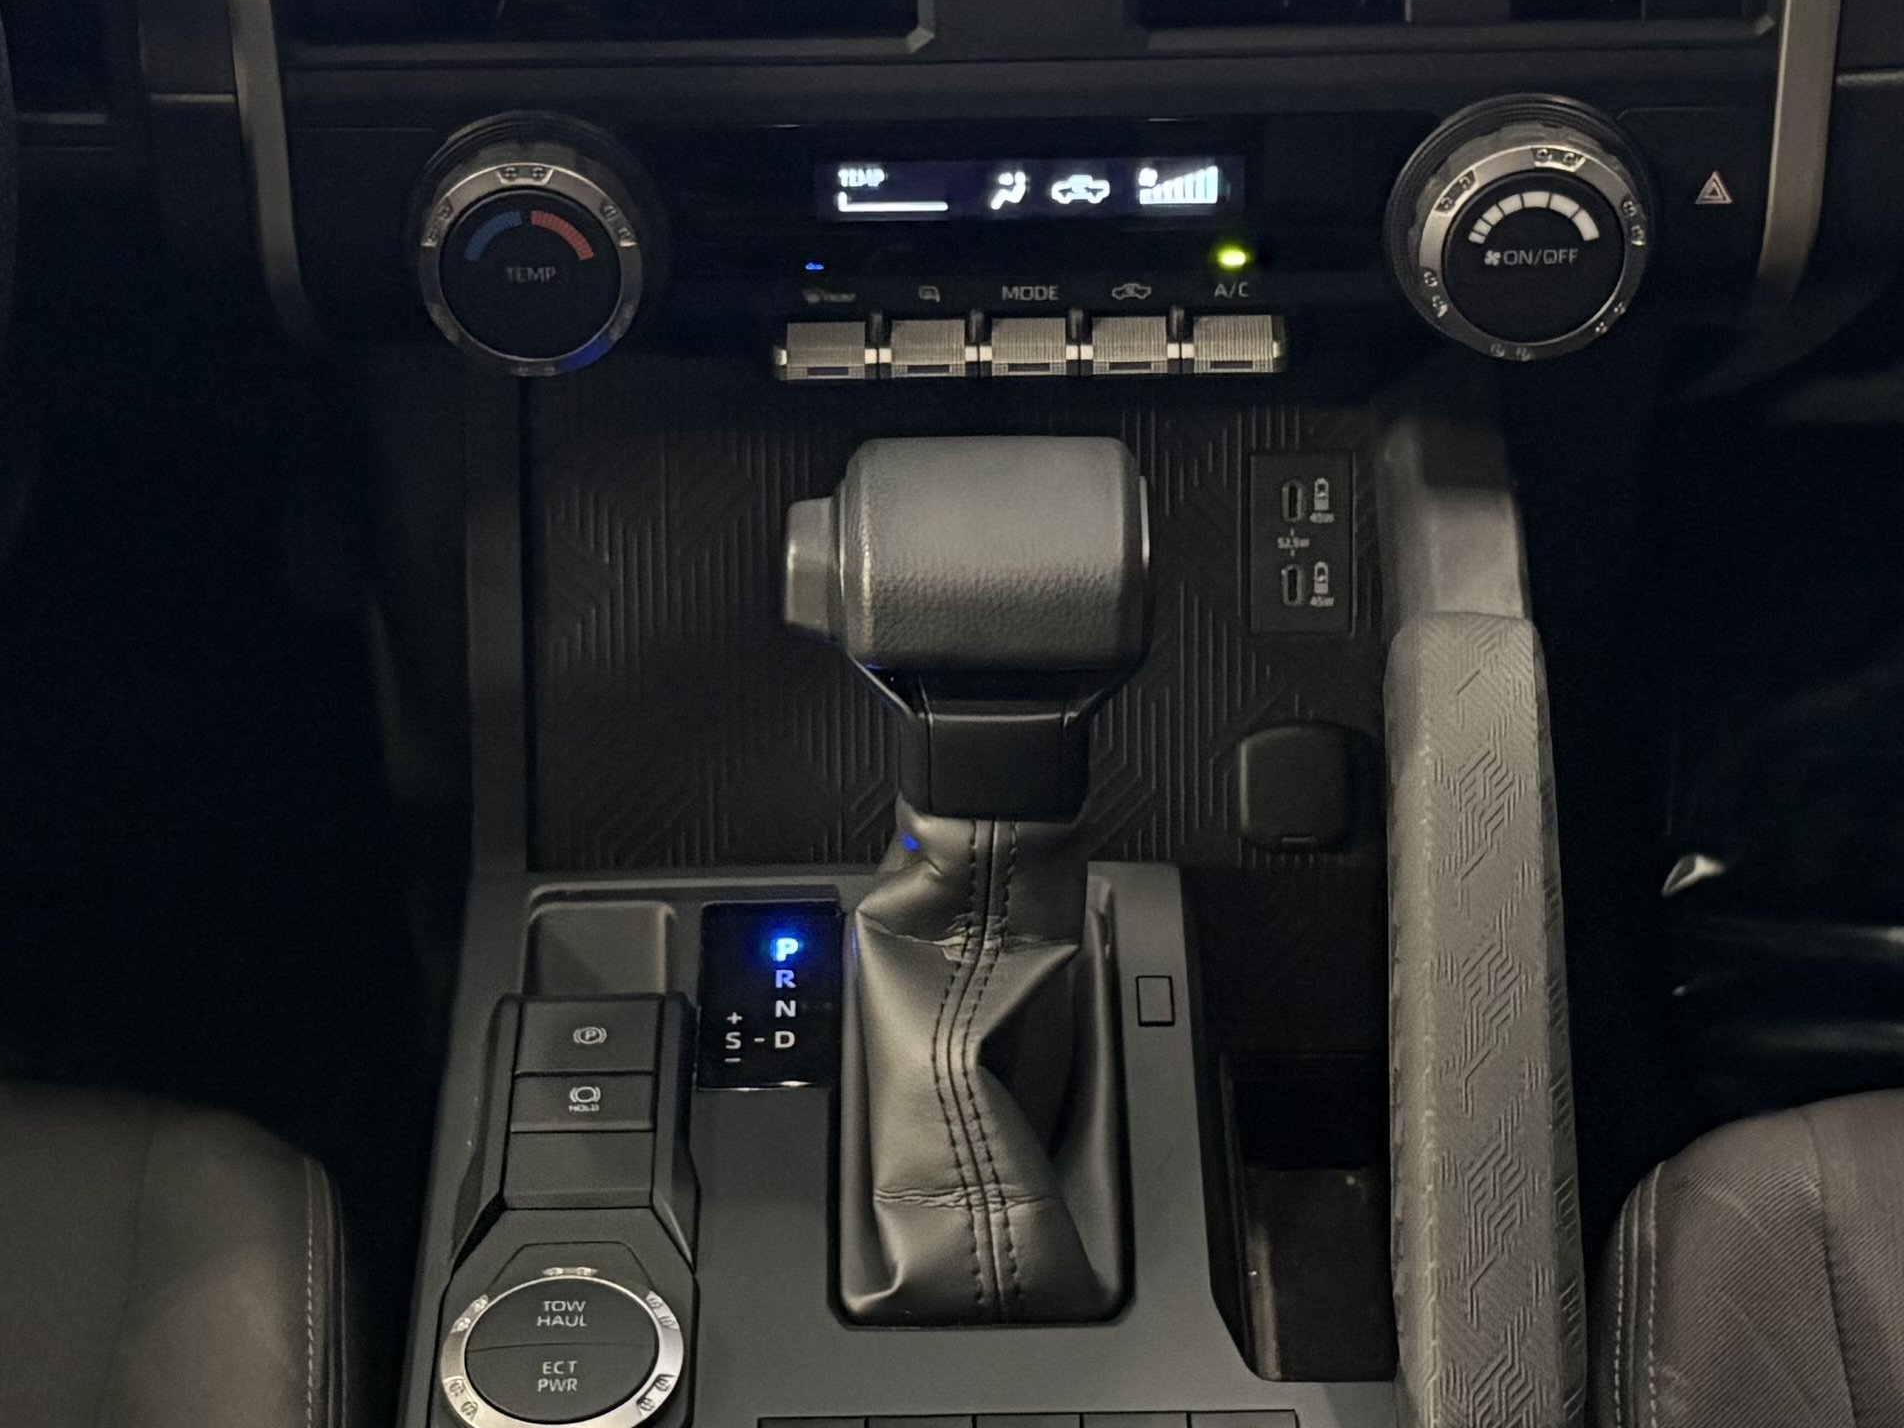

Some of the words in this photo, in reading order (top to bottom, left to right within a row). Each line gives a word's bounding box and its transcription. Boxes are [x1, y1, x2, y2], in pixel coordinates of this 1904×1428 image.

[837, 168, 885, 188] TEMP
[1502, 248, 1579, 266] ON/OFF
[506, 266, 557, 283] TEMP
[1001, 285, 1059, 301] MODE
[1213, 281, 1249, 299] A/C
[775, 936, 799, 962] P
[775, 968, 797, 989] R
[775, 999, 797, 1018] N
[724, 1031, 742, 1050] S
[774, 1030, 796, 1049] D
[543, 1299, 587, 1312] TOW
[536, 1314, 588, 1328] HAUL
[542, 1360, 578, 1375] ECT
[537, 1377, 578, 1393] PWR
